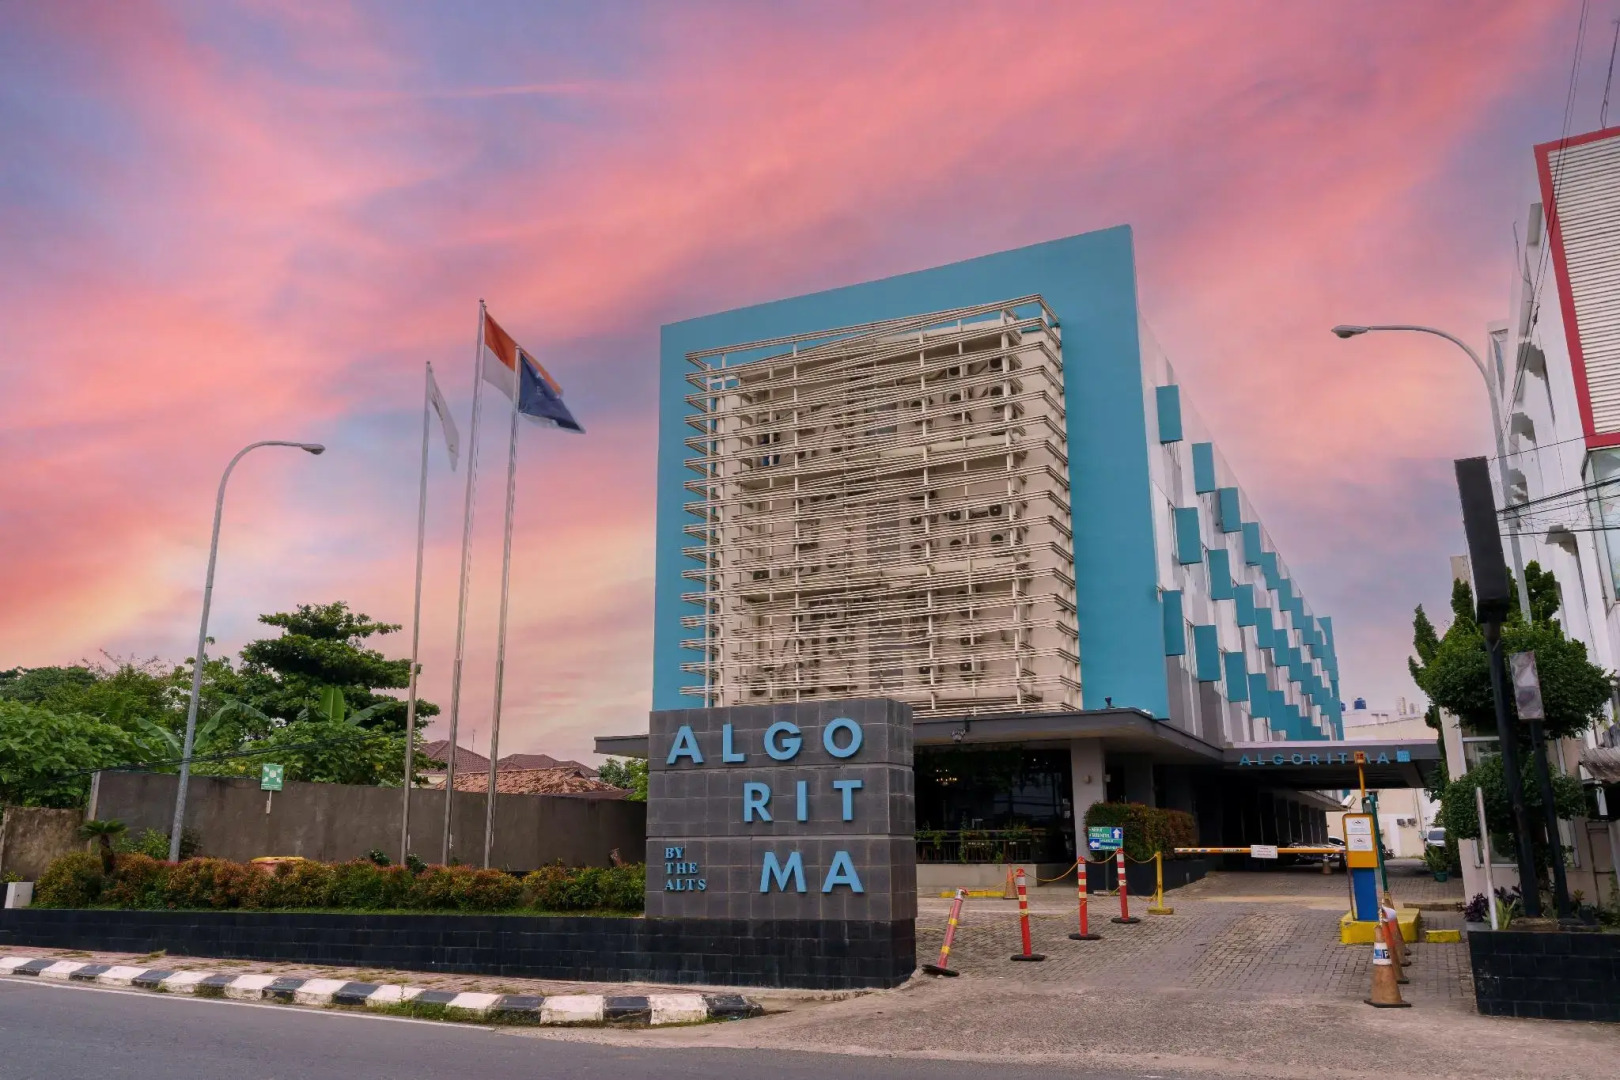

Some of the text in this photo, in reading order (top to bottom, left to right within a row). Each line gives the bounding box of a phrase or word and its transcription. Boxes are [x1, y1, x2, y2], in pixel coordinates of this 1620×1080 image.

[666, 717, 863, 764] ALGO
[743, 780, 863, 822] RIT
[665, 847, 683, 859] BY
[665, 862, 698, 874] THE
[759, 851, 865, 893] MA
[665, 878, 706, 891] ALTS
